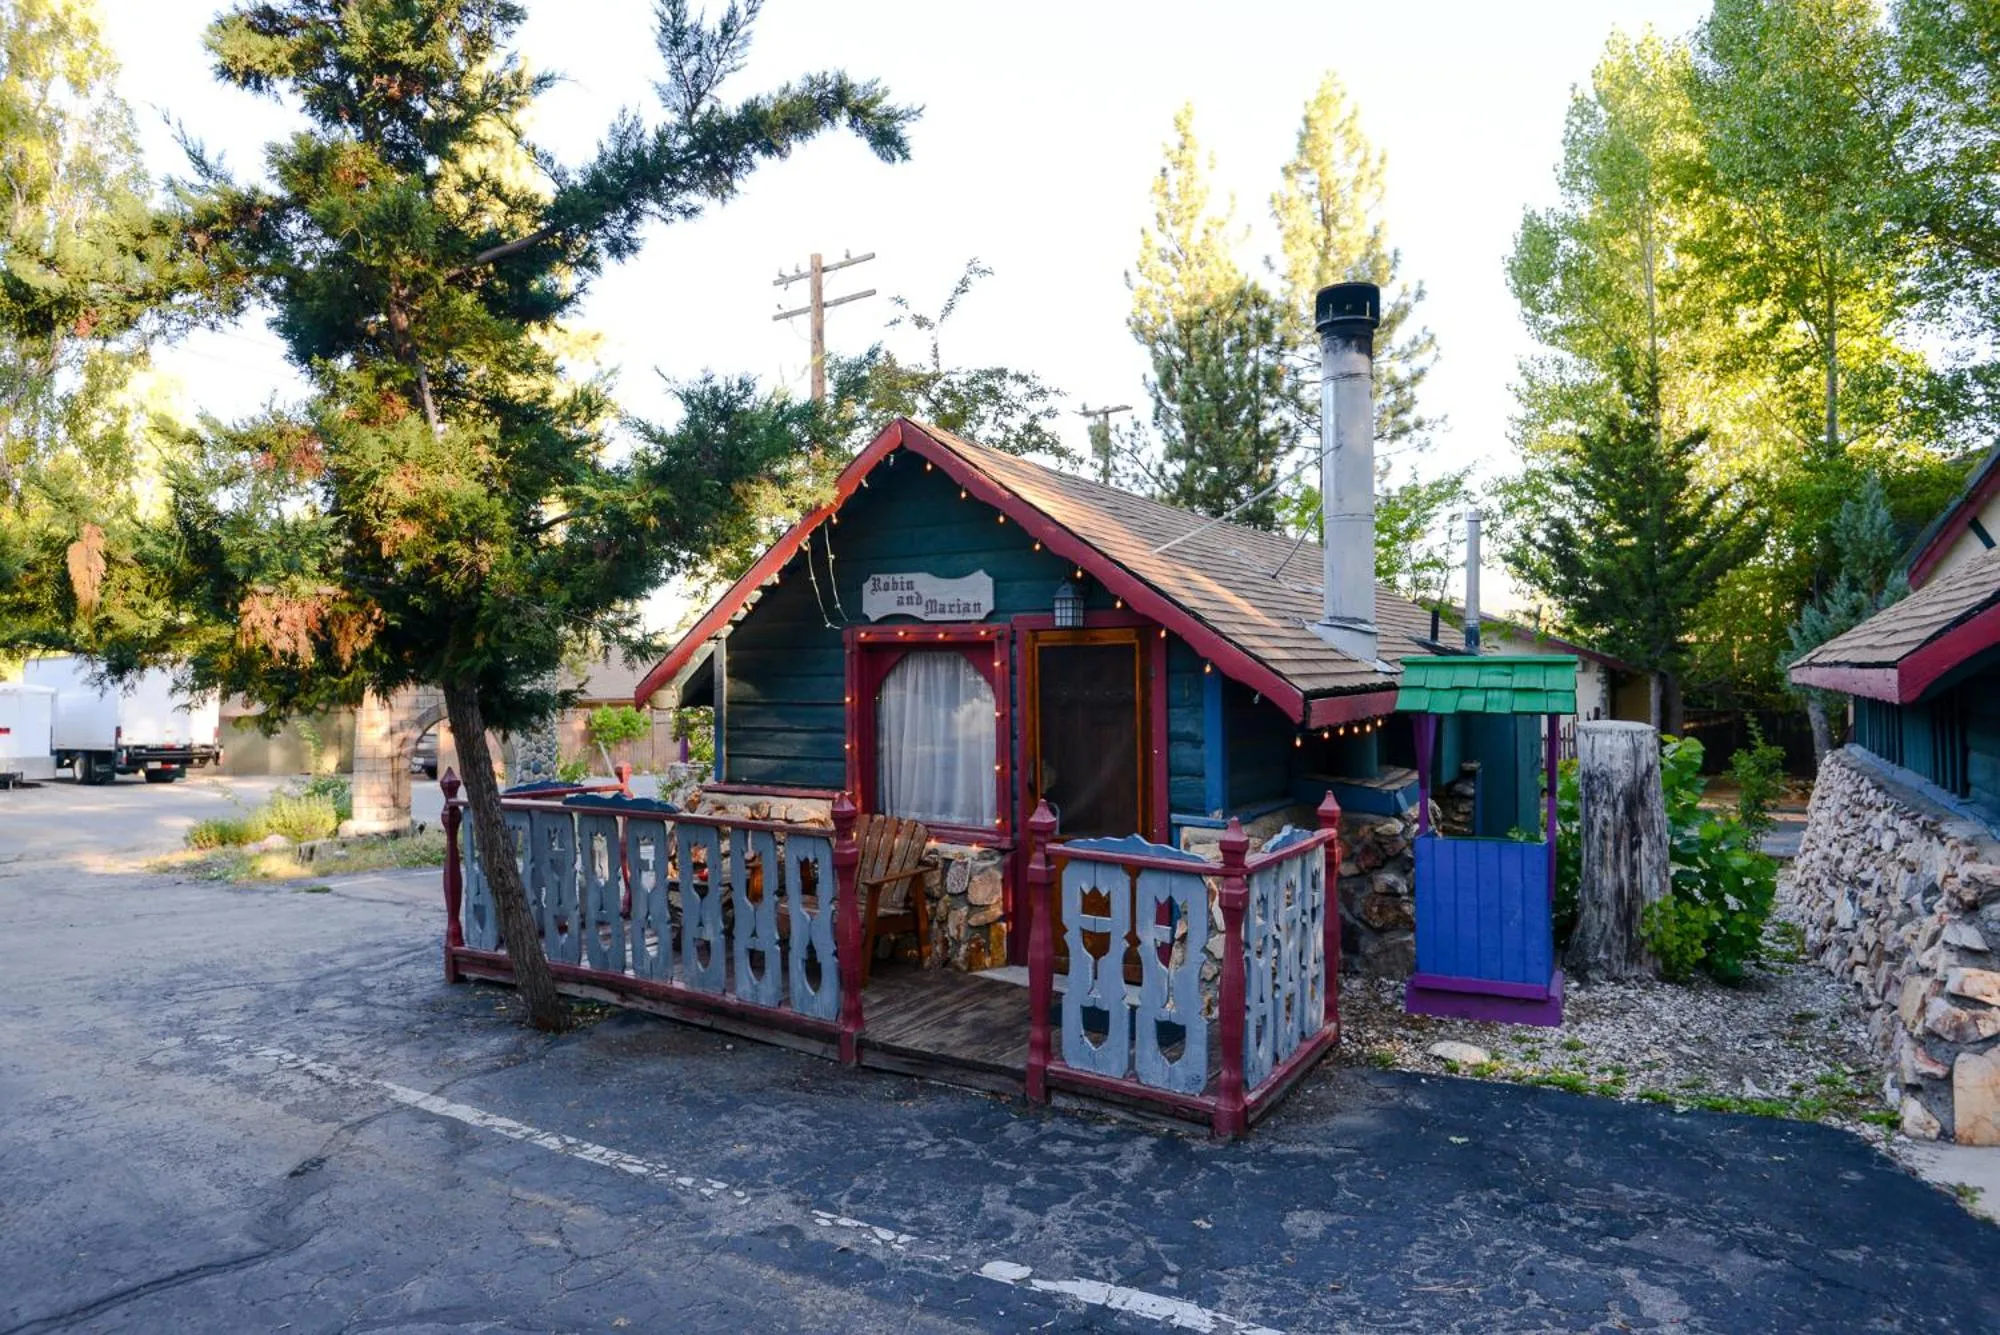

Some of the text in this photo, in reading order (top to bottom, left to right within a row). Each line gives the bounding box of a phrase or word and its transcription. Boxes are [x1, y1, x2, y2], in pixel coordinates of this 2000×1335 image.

[870, 576, 915, 595] Robin
[896, 592, 923, 606] and
[924, 598, 982, 616] Marian
